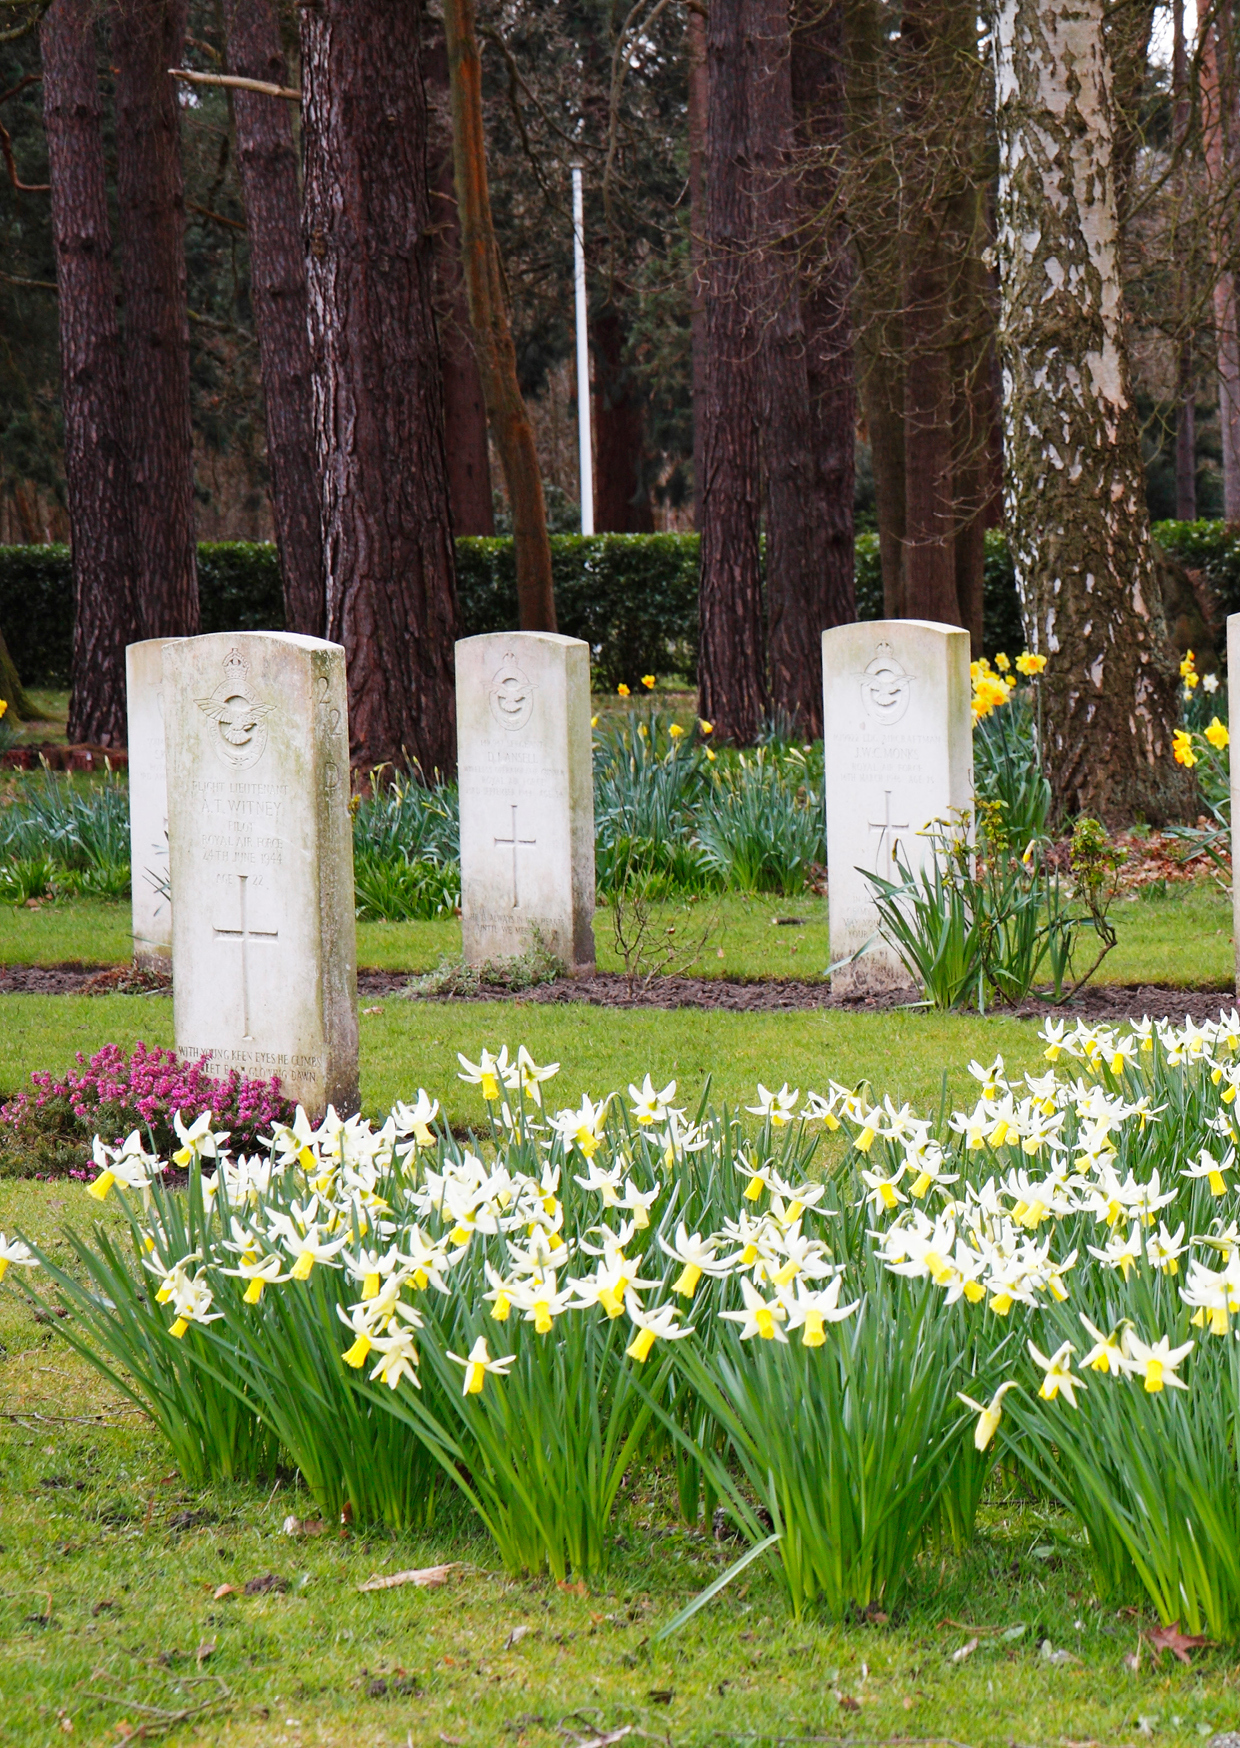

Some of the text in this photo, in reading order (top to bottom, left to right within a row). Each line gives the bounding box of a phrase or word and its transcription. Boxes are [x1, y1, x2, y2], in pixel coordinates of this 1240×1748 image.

[884, 747, 920, 760] MONKS
[192, 780, 289, 796] FLIGHT LIEUTENANT
[228, 799, 282, 817] WITNEY
[228, 820, 253, 832] PILOT
[201, 834, 283, 850] ROYAL AIR FORCE
[233, 851, 256, 864] JUNE
[260, 853, 283, 866] 1944
[216, 873, 233, 885] AGE
[177, 1045, 199, 1058] WITH
[254, 1051, 276, 1065] EYES
[277, 1053, 288, 1066] HE
